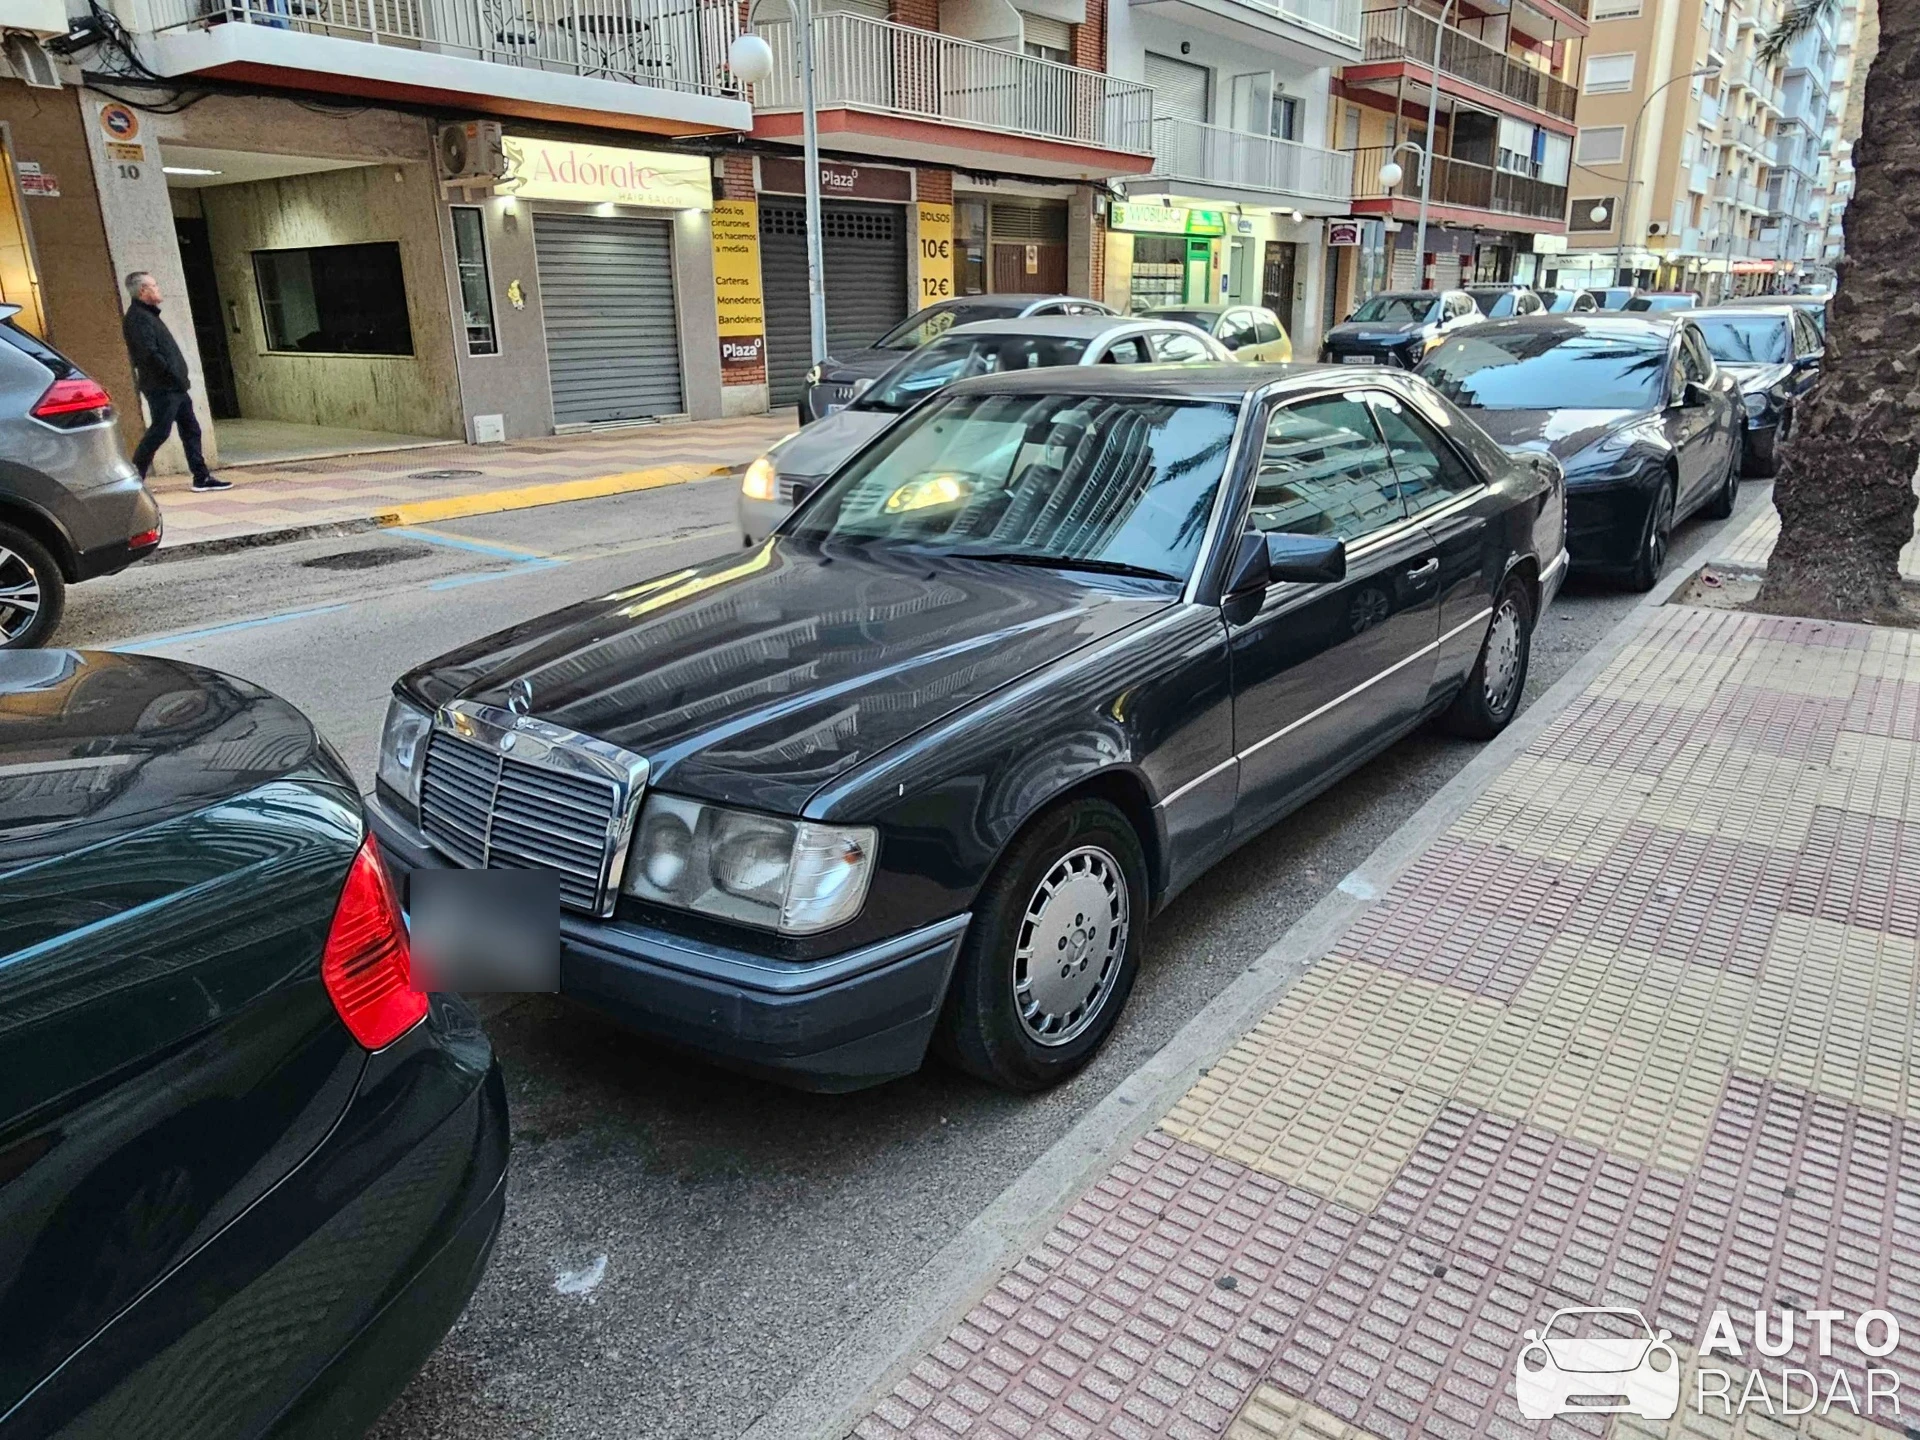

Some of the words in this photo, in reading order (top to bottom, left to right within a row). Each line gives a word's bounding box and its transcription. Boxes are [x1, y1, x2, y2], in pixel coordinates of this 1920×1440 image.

[118, 164, 140, 180] 10
[534, 149, 657, 190] Adórate
[619, 192, 643, 202] HAIR
[649, 194, 682, 205] SALON
[711, 206, 733, 215] odos
[734, 206, 744, 216] los
[711, 217, 750, 228] cinturones
[920, 211, 950, 223] BOLSOS
[712, 231, 724, 240] los
[725, 231, 756, 241] hacemos
[722, 244, 748, 253] medida
[921, 238, 949, 259] 10€
[715, 276, 749, 286] Carteras
[922, 278, 949, 296] 12€
[717, 295, 761, 305] Monederos
[718, 315, 762, 325] Bandoleras
